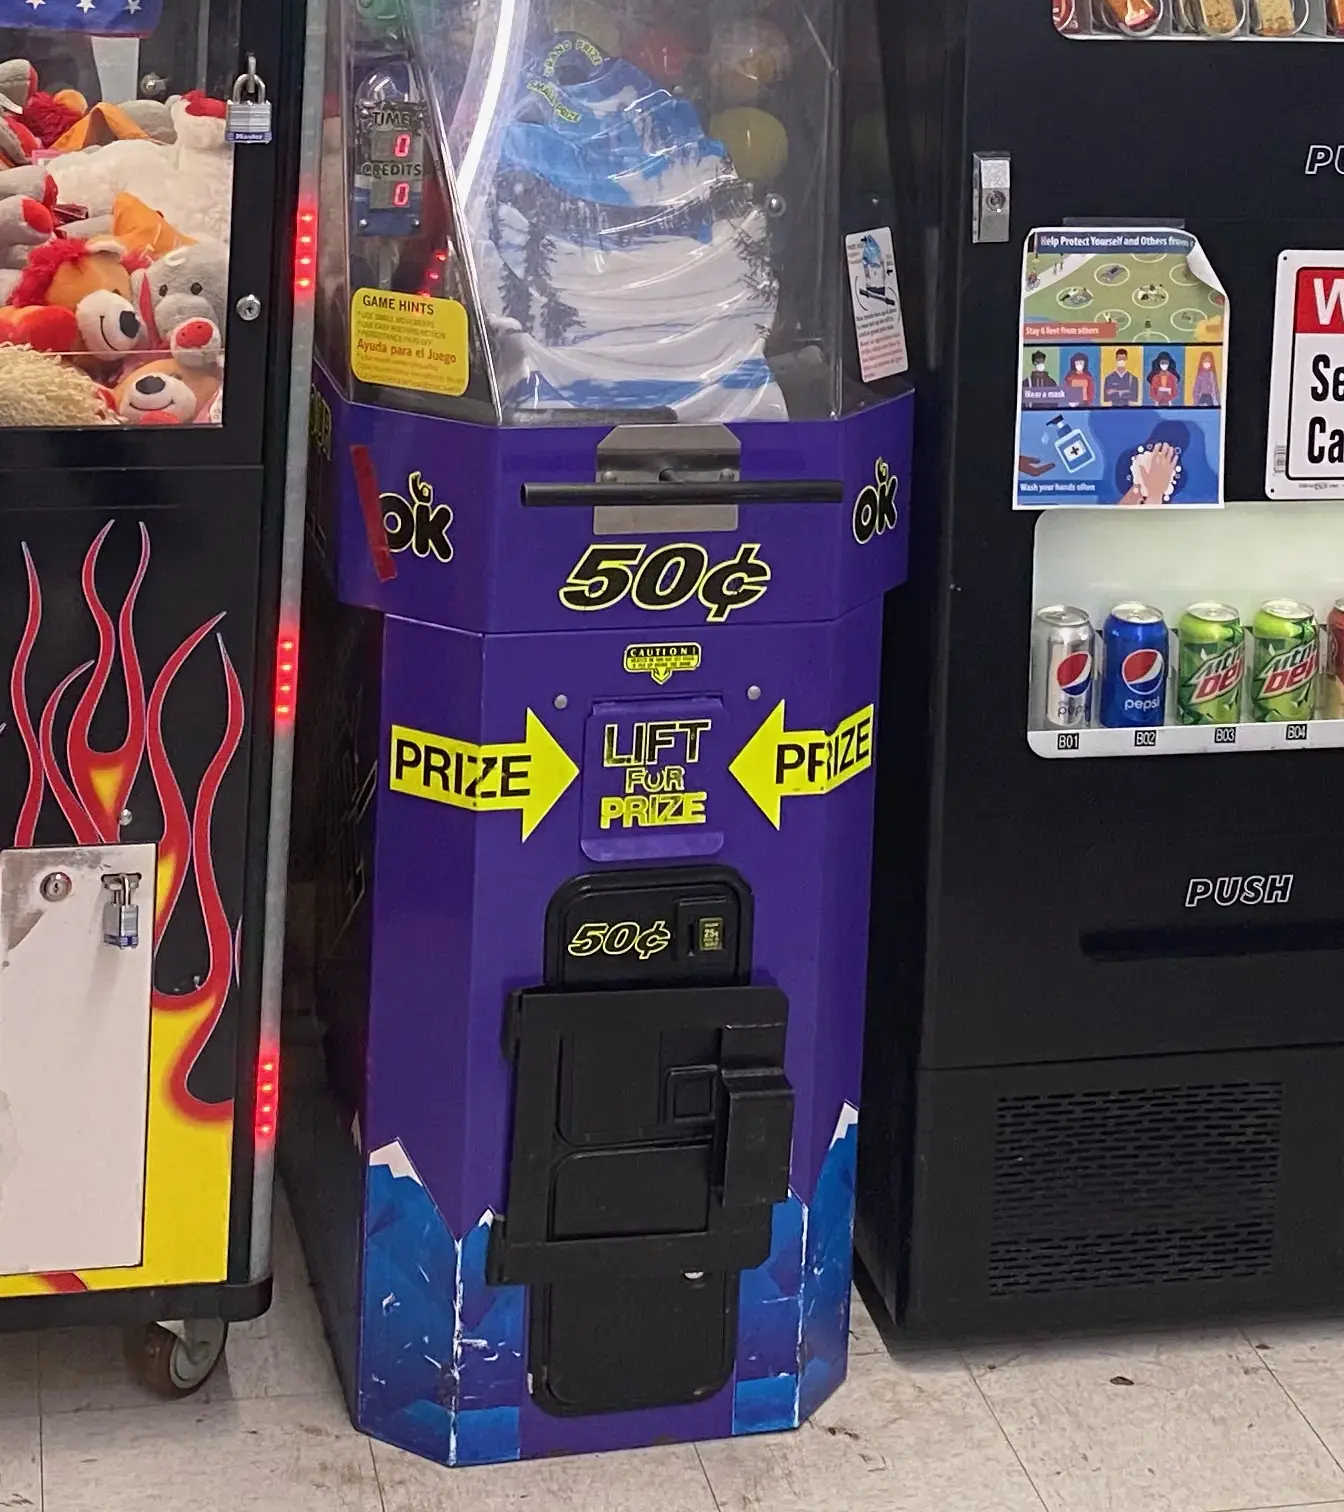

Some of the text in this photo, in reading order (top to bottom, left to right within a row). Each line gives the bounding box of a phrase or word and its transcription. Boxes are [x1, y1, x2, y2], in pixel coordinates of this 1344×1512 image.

[543, 40, 572, 77] GRAND
[576, 40, 603, 66] PRIZE
[373, 111, 409, 126] TIME
[394, 134, 410, 157] 0
[362, 162, 422, 177] CREDITS
[394, 182, 409, 207] 0
[1041, 235, 1058, 248] Help
[1060, 236, 1090, 246] Protect
[1091, 235, 1123, 246] Yourself
[1124, 236, 1139, 245] and
[1141, 236, 1167, 246] Others
[363, 295, 434, 316] GAME HINTS
[1026, 326, 1039, 337] Stay
[1047, 326, 1060, 335] feet
[1060, 326, 1077, 335] from
[1078, 326, 1099, 335] others
[358, 338, 457, 365] Ayuda para el Juego
[1025, 389, 1042, 399] Wear
[1048, 389, 1065, 399] mask
[1020, 482, 1038, 491] Wash
[1039, 484, 1054, 493] your
[1054, 483, 1075, 491] hands
[559, 543, 772, 622] 50¢
[1124, 696, 1160, 712] pepsi
[1058, 734, 1078, 749] B01
[1136, 731, 1155, 746] B02
[1216, 728, 1235, 742] B03
[1287, 725, 1306, 739] B04
[602, 720, 711, 768] LIFT
[776, 717, 870, 785] PRIZE
[393, 738, 532, 799] PRIZE
[625, 767, 684, 792] FOR
[600, 792, 707, 829] PRIZE
[1185, 874, 1293, 907] PUSH
[568, 921, 670, 959] 50¢
